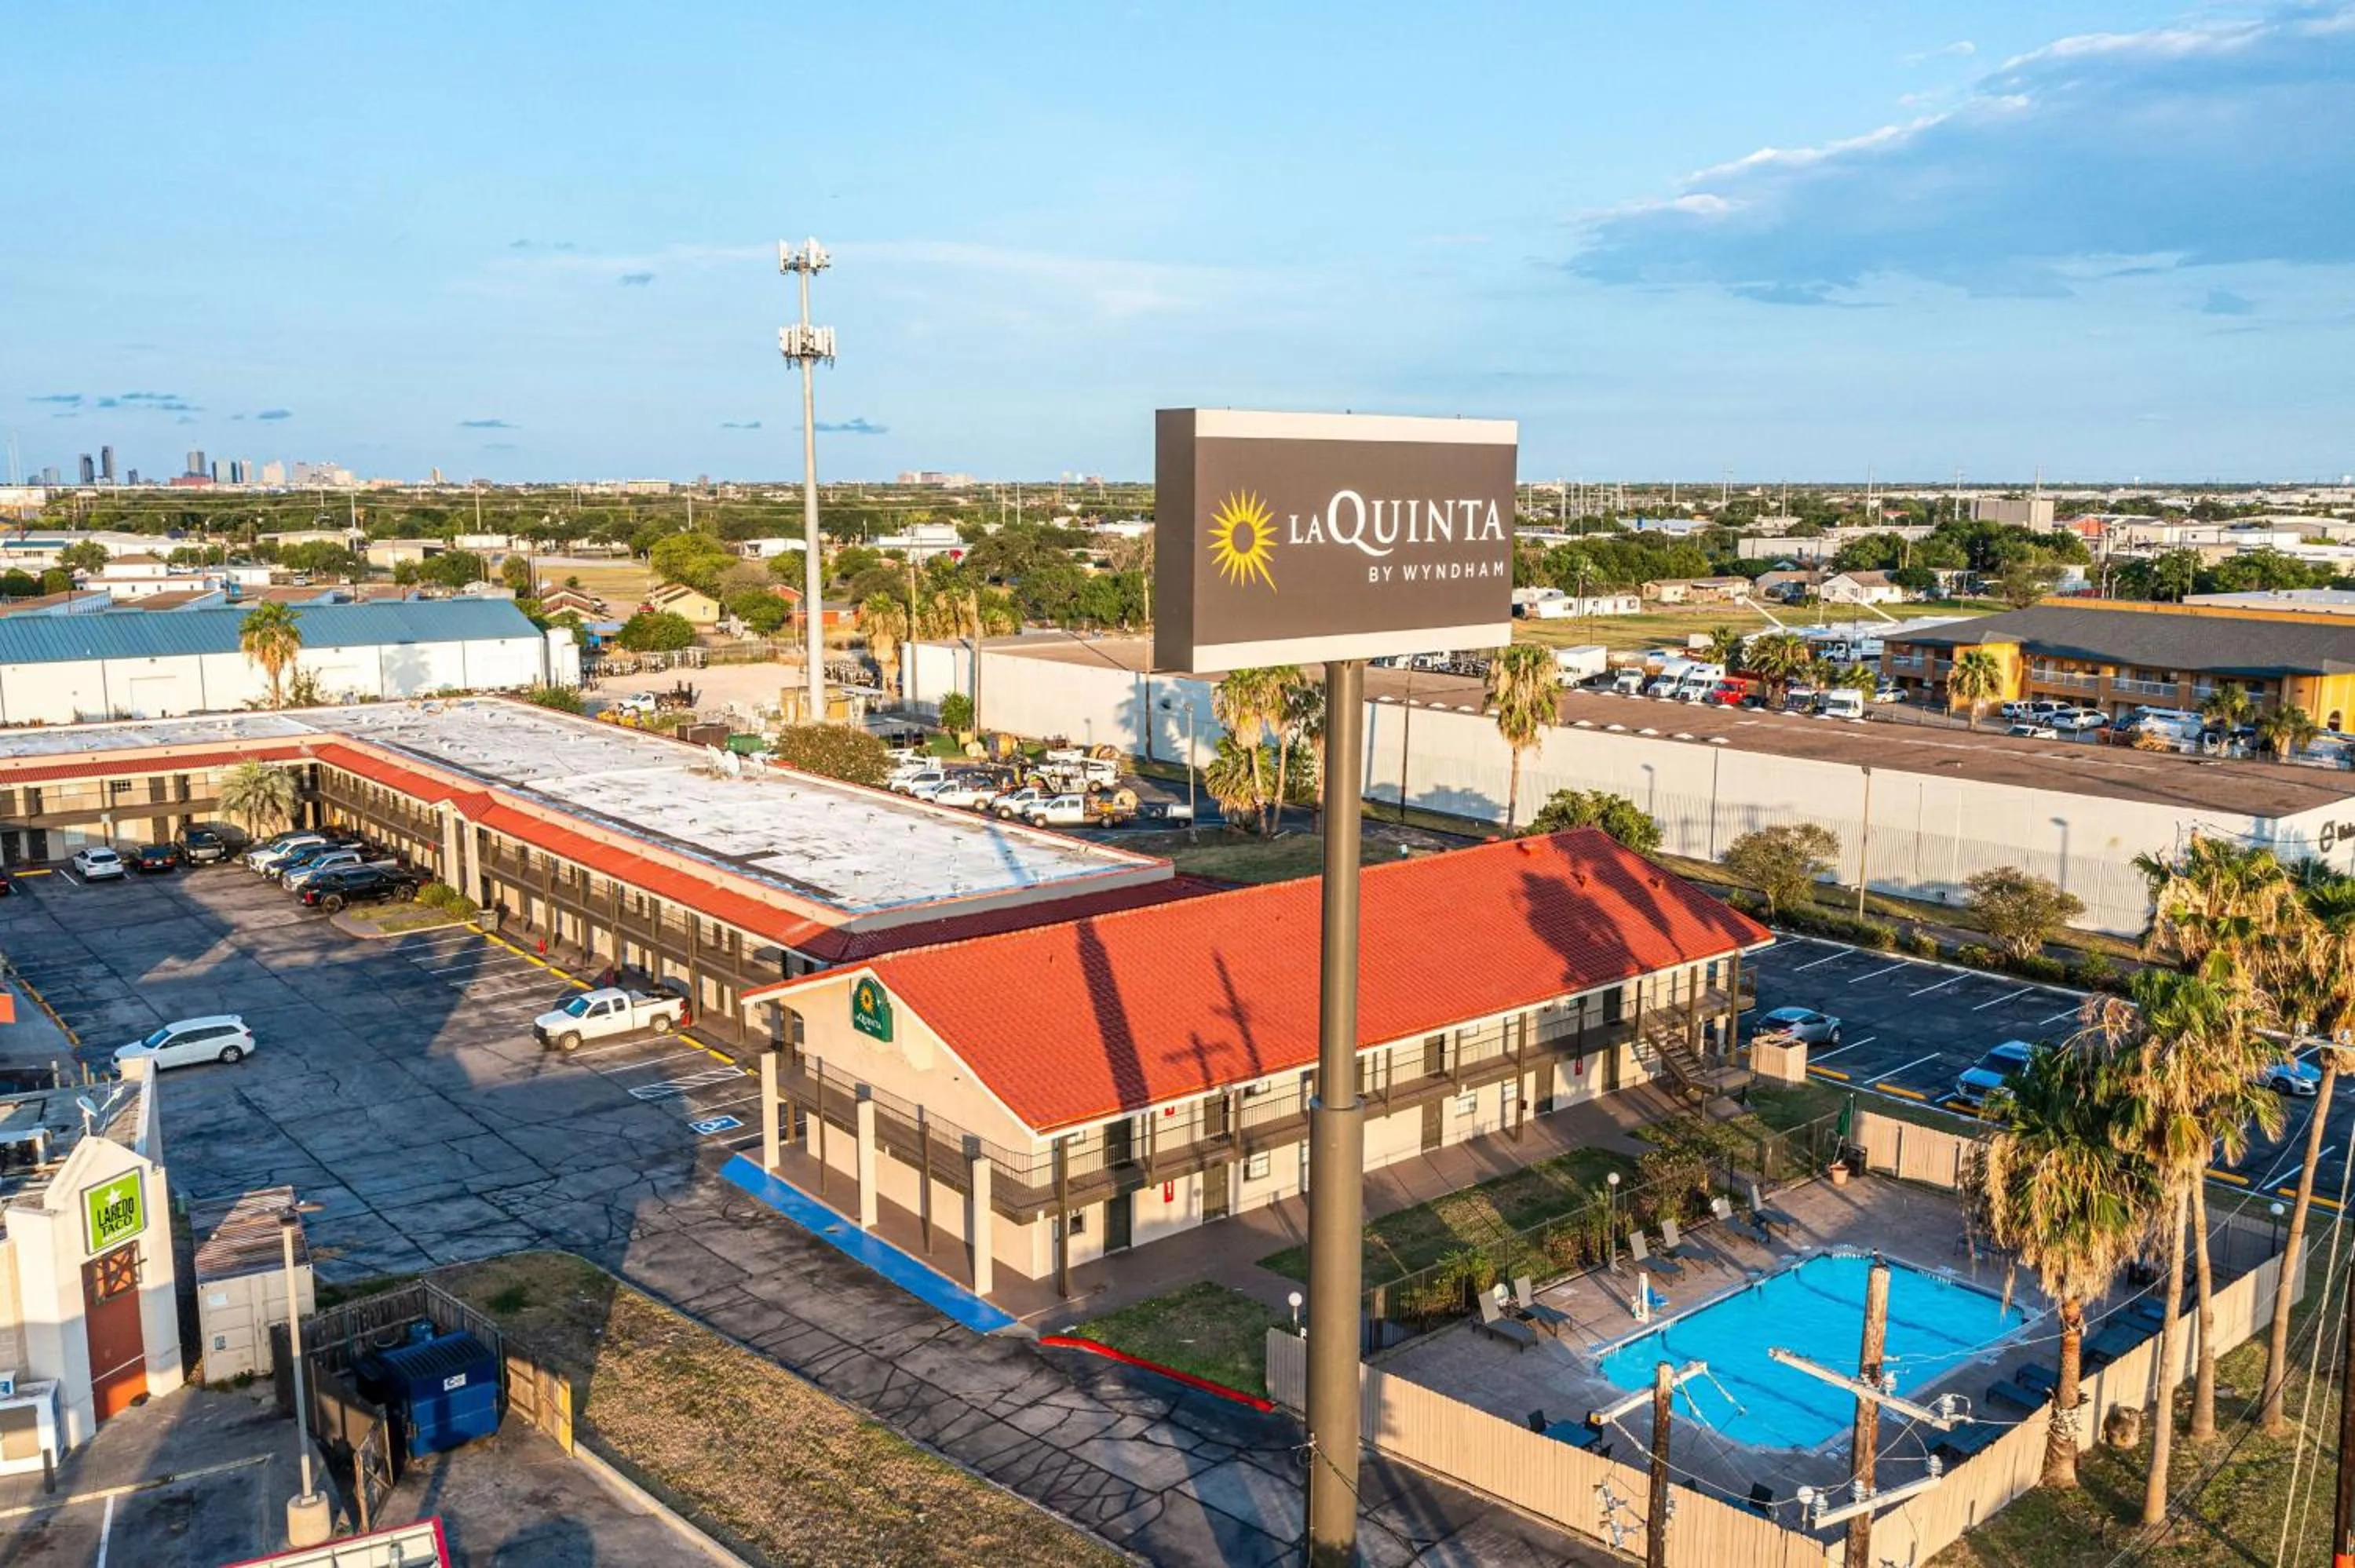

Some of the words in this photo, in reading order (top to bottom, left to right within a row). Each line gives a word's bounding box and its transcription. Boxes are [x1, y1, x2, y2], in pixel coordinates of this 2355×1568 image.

[1327, 489, 1506, 556] QUINTA
[1368, 565, 1393, 583] BY
[1403, 561, 1505, 582] WYNDHAM
[97, 1196, 134, 1229] LAREDO
[101, 1215, 133, 1238] TACO
